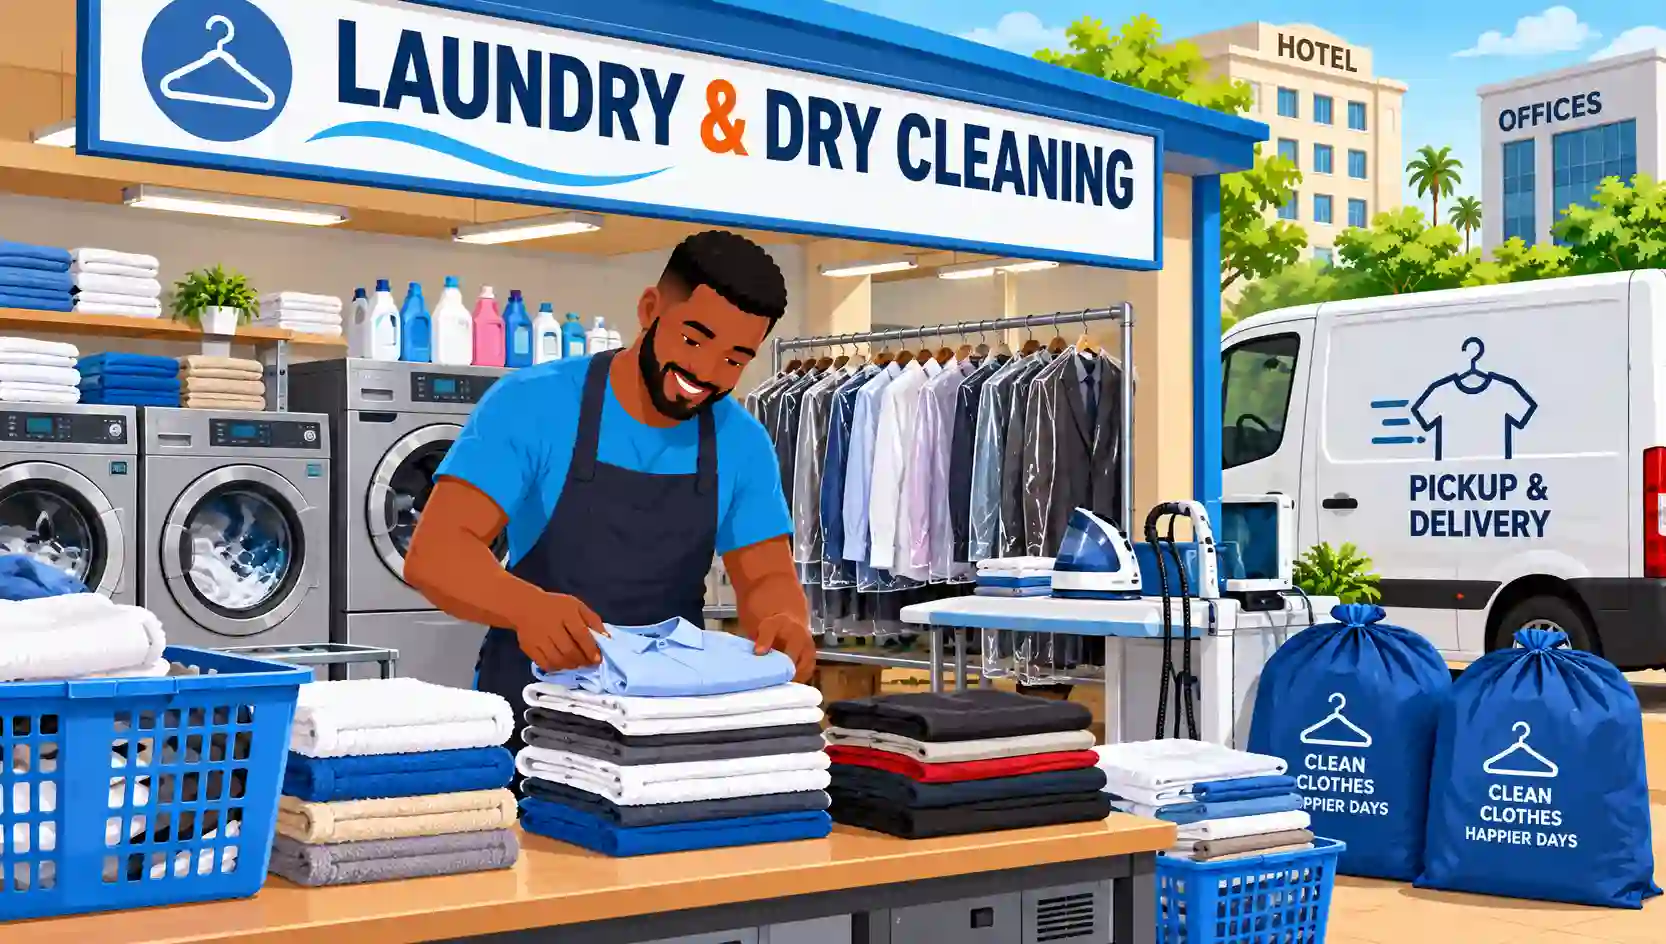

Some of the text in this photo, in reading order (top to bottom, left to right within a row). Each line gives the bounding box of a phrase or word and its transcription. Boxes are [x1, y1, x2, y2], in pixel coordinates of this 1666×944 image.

[1277, 32, 1358, 73] HOTEL
[338, 18, 1134, 210] LAUNDRY & DRY CLEANING
[1498, 91, 1603, 132] OFFICES
[1410, 472, 1549, 501] PICKUP &
[1410, 509, 1551, 538] DELIVERY
[1304, 753, 1366, 774] CLEAN
[1296, 774, 1375, 795] CLOTHES
[1488, 783, 1552, 805] CLEAN
[1300, 797, 1389, 816] PPIER DAYS
[1480, 805, 1563, 827] CLOTHES
[1465, 826, 1578, 848] HAPPIER DAYS
